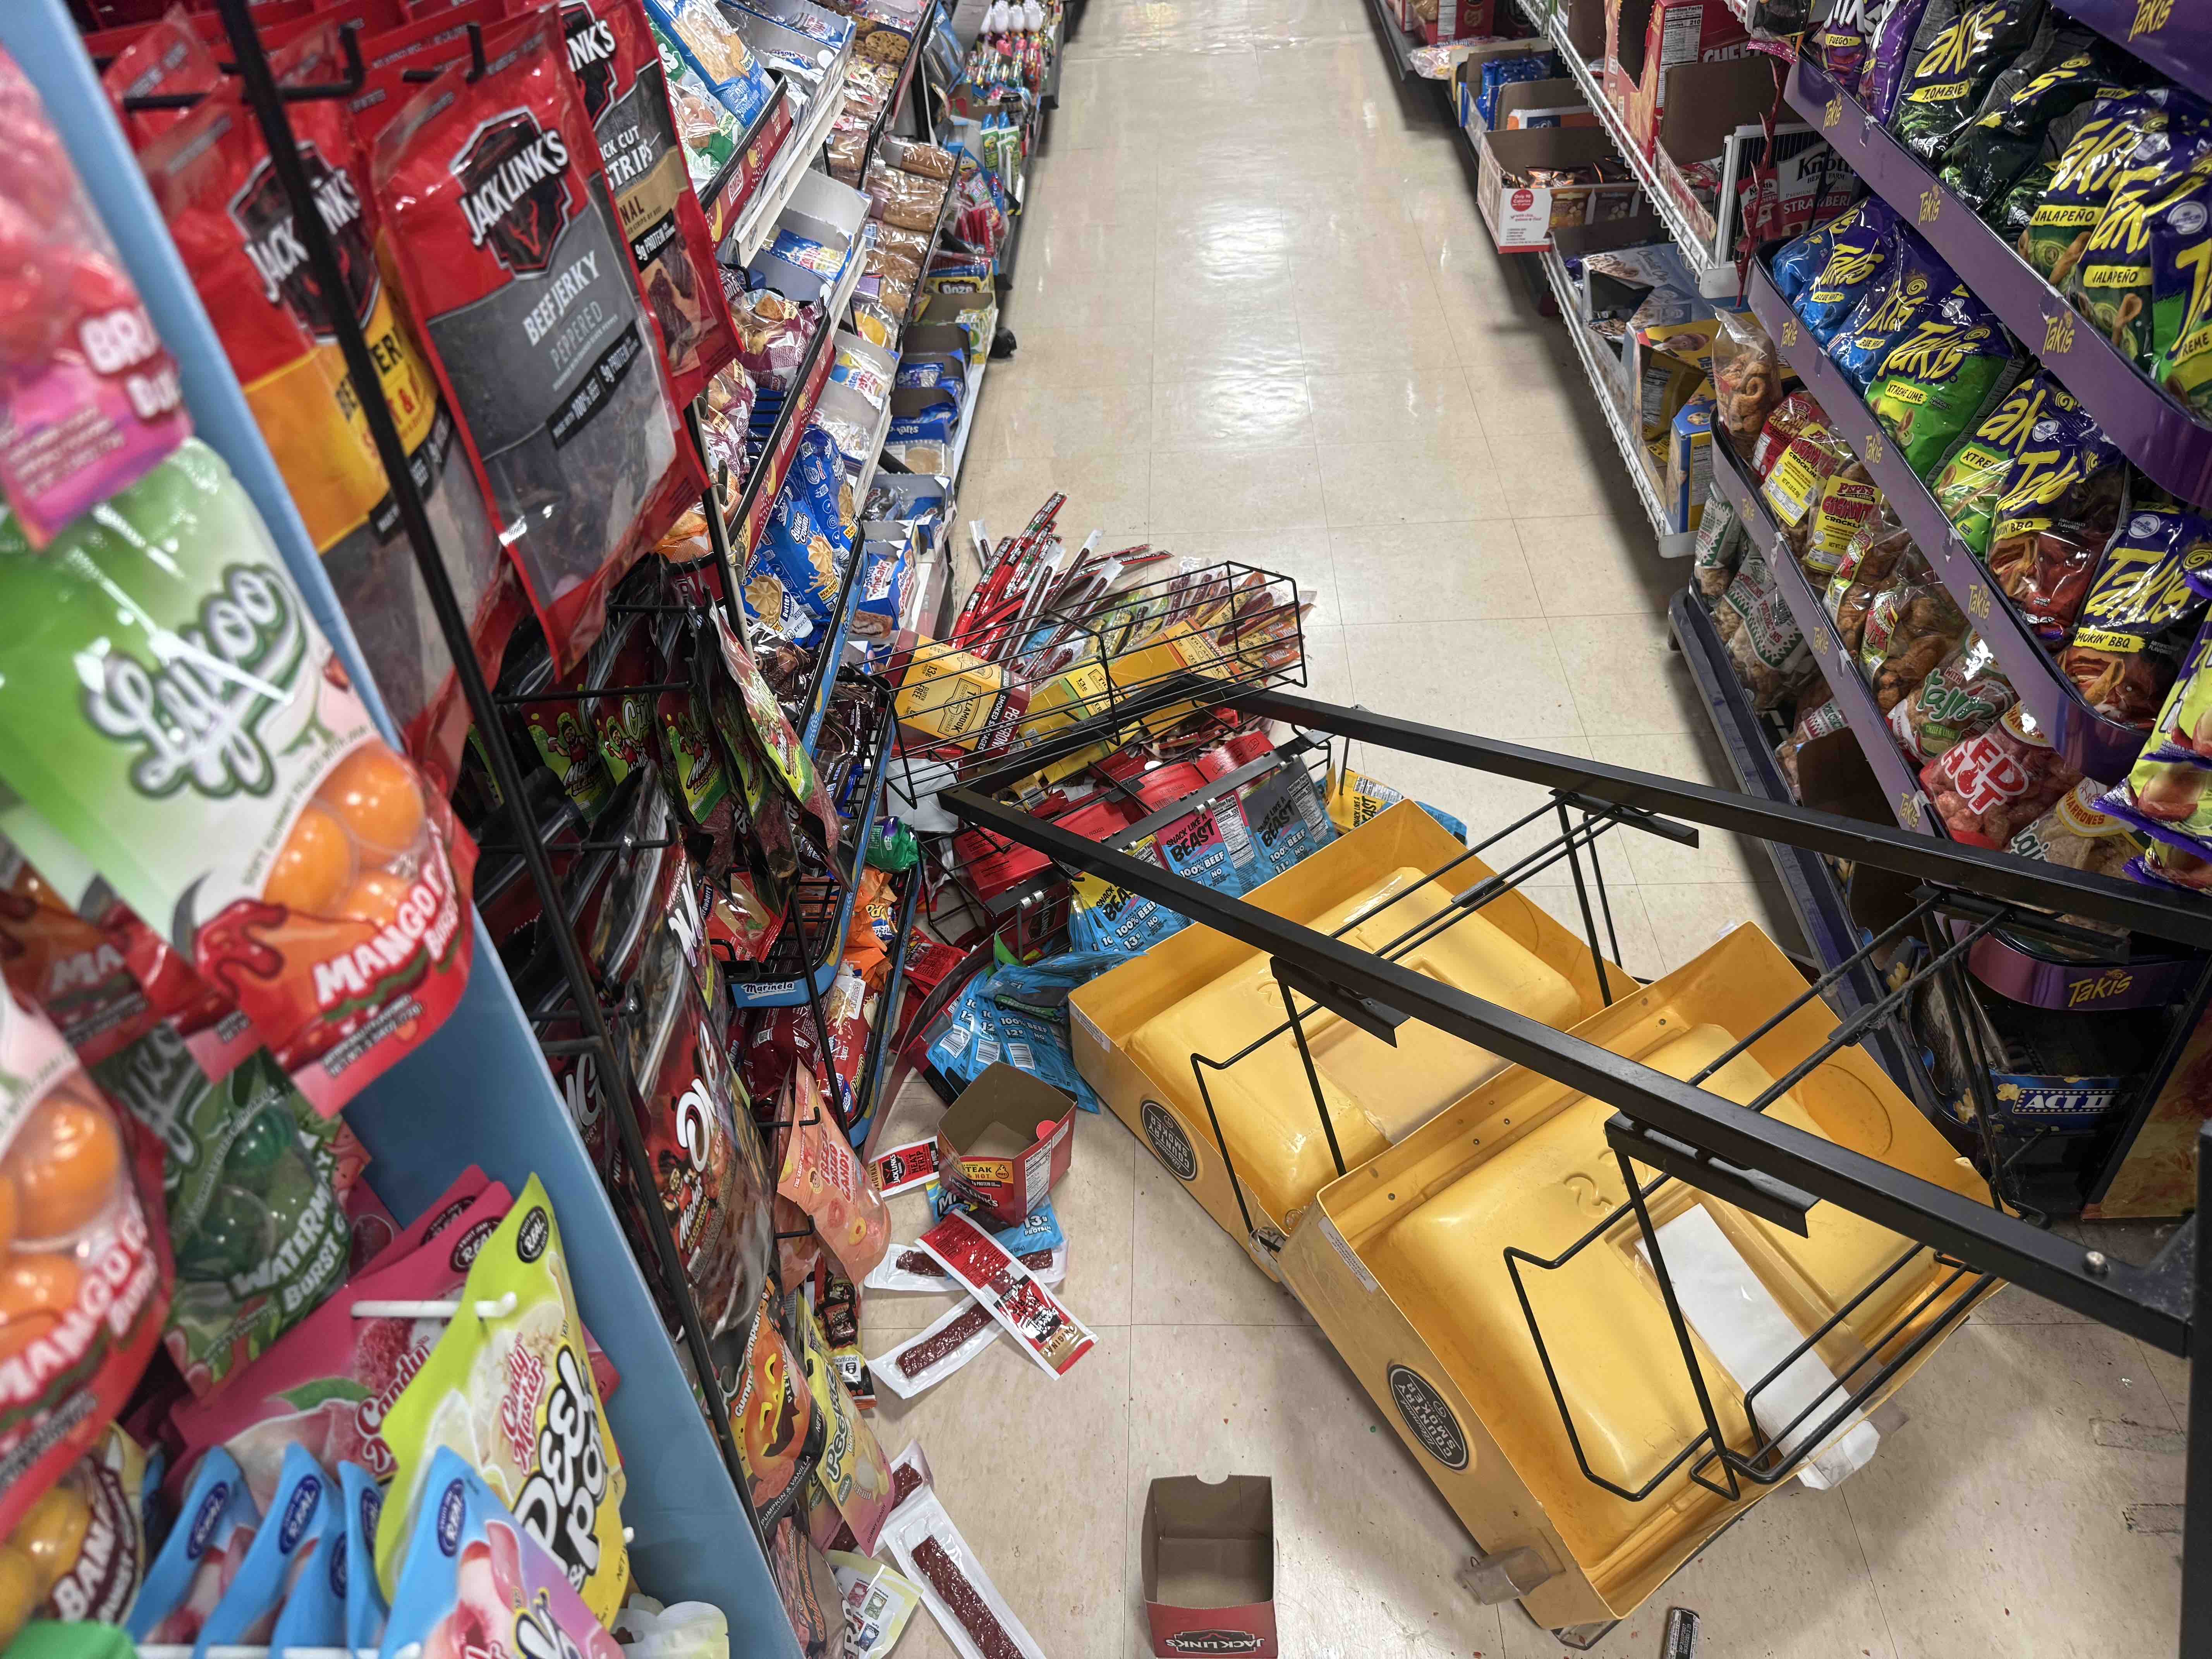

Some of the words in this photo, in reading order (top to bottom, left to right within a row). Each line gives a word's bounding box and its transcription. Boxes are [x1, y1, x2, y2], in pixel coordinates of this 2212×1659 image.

[2129, 0, 2171, 42] Takis
[567, 19, 616, 73] INK'S
[1829, 36, 1849, 46] FUEGO
[1923, 84, 1963, 101] ZOMBIE
[1823, 98, 1843, 131] Takis
[618, 125, 639, 149] CUT
[460, 176, 509, 247] JACK
[1918, 192, 1941, 225] Takis
[2034, 208, 2095, 222] JALAPEÑO
[644, 225, 665, 256] PROTEIN
[2092, 271, 2138, 284] JALAPEÑO
[522, 299, 557, 347] BEEF
[552, 250, 601, 316] JERKY
[549, 301, 603, 371] PEPPERED
[1781, 320, 1798, 348] Takis
[2042, 317, 2075, 355] Takis
[1877, 321, 1980, 380] Takis
[1887, 383, 1907, 398] XTREME
[1907, 388, 1923, 402] LIME
[1865, 435, 1883, 464] Takis
[2009, 520, 2034, 532] BBQ
[2084, 546, 2193, 624] Takis
[782, 592, 791, 619] Butter
[1968, 584, 1991, 620] Takis
[1813, 627, 1829, 655] Takis
[2109, 636, 2131, 649] BBQ
[1944, 666, 1963, 685] WITH
[912, 684, 924, 700] FREE
[988, 694, 1006, 722] SMOKED
[1166, 827, 1187, 848] SNACK
[1187, 820, 1201, 836] LIKE
[1201, 813, 1207, 825] A
[1257, 815, 1272, 834] SNACK
[1262, 803, 1295, 848] BEAST
[1171, 818, 1215, 862] BEAST
[1269, 843, 1288, 863] 100%
[1288, 830, 1307, 850] BEEF
[1294, 844, 1305, 856] NO
[1179, 863, 1204, 878] 100%
[1204, 851, 1225, 870] BEEF
[1210, 867, 1223, 879] NO
[701, 885, 713, 916] trawberry
[1096, 886, 1115, 909] SNACK
[1115, 917, 1140, 938] 100%
[1146, 915, 1158, 928] NO
[313, 890, 438, 1006] MANGO
[742, 981, 795, 994] Marinela
[2068, 974, 2134, 1008] Takis
[1026, 1022, 1048, 1033] BEEF
[2025, 1094, 2073, 1110] ACT
[1147, 1115, 1189, 1156] SMOKER
[1147, 1123, 1191, 1168] COUNTRY
[839, 1147, 852, 1202] CANDY
[524, 1220, 546, 1251] REAL
[1024, 1225, 1051, 1236] PROTEIN
[282, 1239, 341, 1314] BURST
[501, 1344, 532, 1442] Candy
[1398, 1383, 1453, 1458] COUNTRY
[1406, 1382, 1455, 1449] SMOKER
[789, 1456, 811, 1487] VANILLA
[867, 1522, 878, 1544] GUMMY
[1220, 1639, 1265, 1648] JACK
